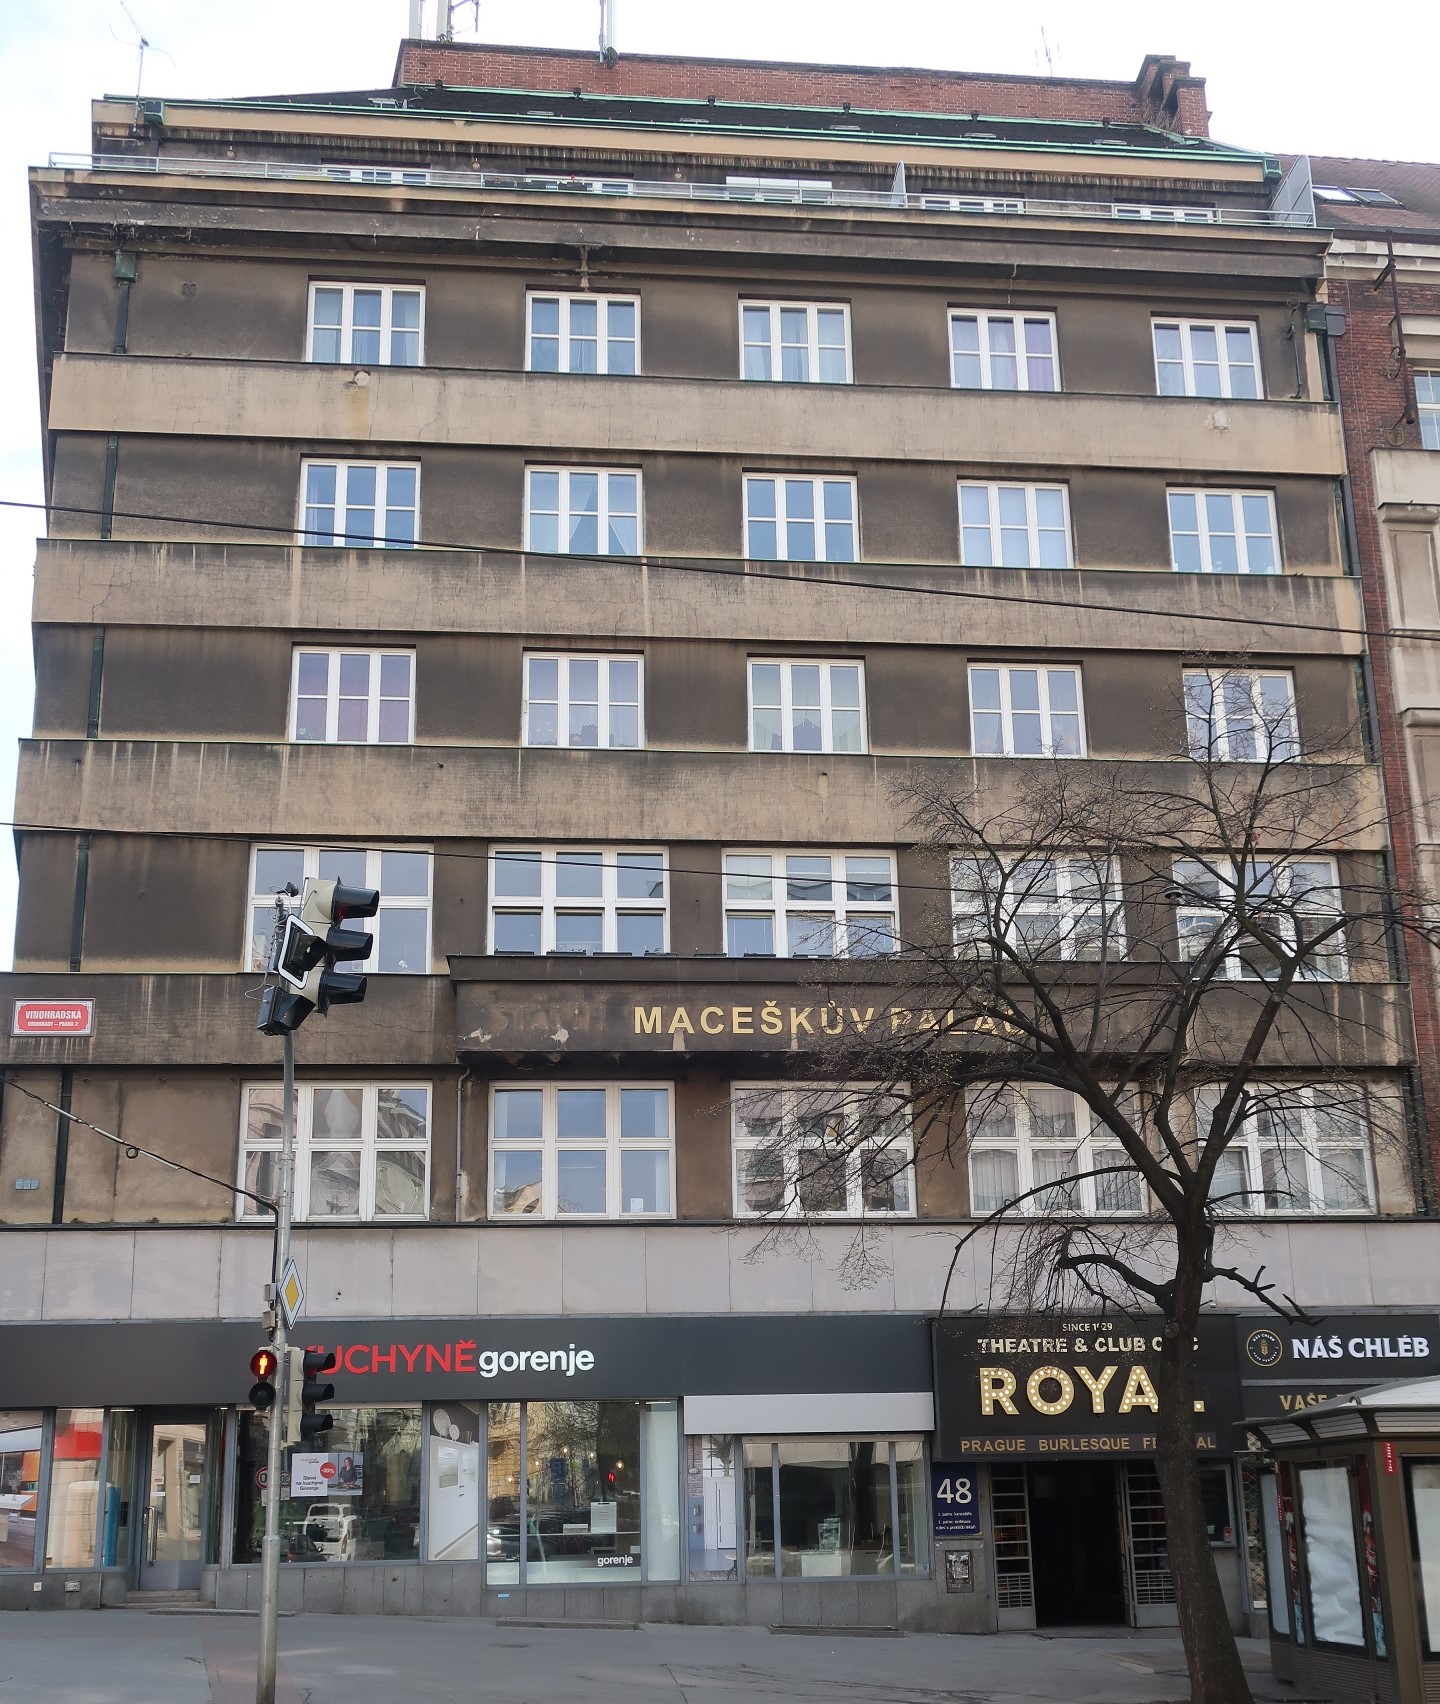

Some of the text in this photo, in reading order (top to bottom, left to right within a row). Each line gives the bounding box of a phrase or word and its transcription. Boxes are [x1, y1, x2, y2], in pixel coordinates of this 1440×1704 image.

[25, 1009, 81, 1019] VINOHRADSKÁ
[634, 1000, 875, 1035] MACEŠKŮV
[1062, 1323, 1091, 1332] SINCE
[306, 1339, 477, 1375] UCHYNĚ
[977, 1338, 1068, 1354] THEATRE
[1074, 1337, 1089, 1352] &
[1094, 1337, 1146, 1352] CLUB
[1292, 1335, 1344, 1359] NÁŠ
[1348, 1335, 1430, 1359] CHLÉB
[479, 1343, 595, 1378] gorenje
[980, 1365, 1205, 1416] ROYA
[961, 1439, 1026, 1453] PRAGUE
[1039, 1437, 1131, 1451] BURLESQUE
[936, 1477, 972, 1504] 48
[597, 1554, 634, 1567] gorenje
